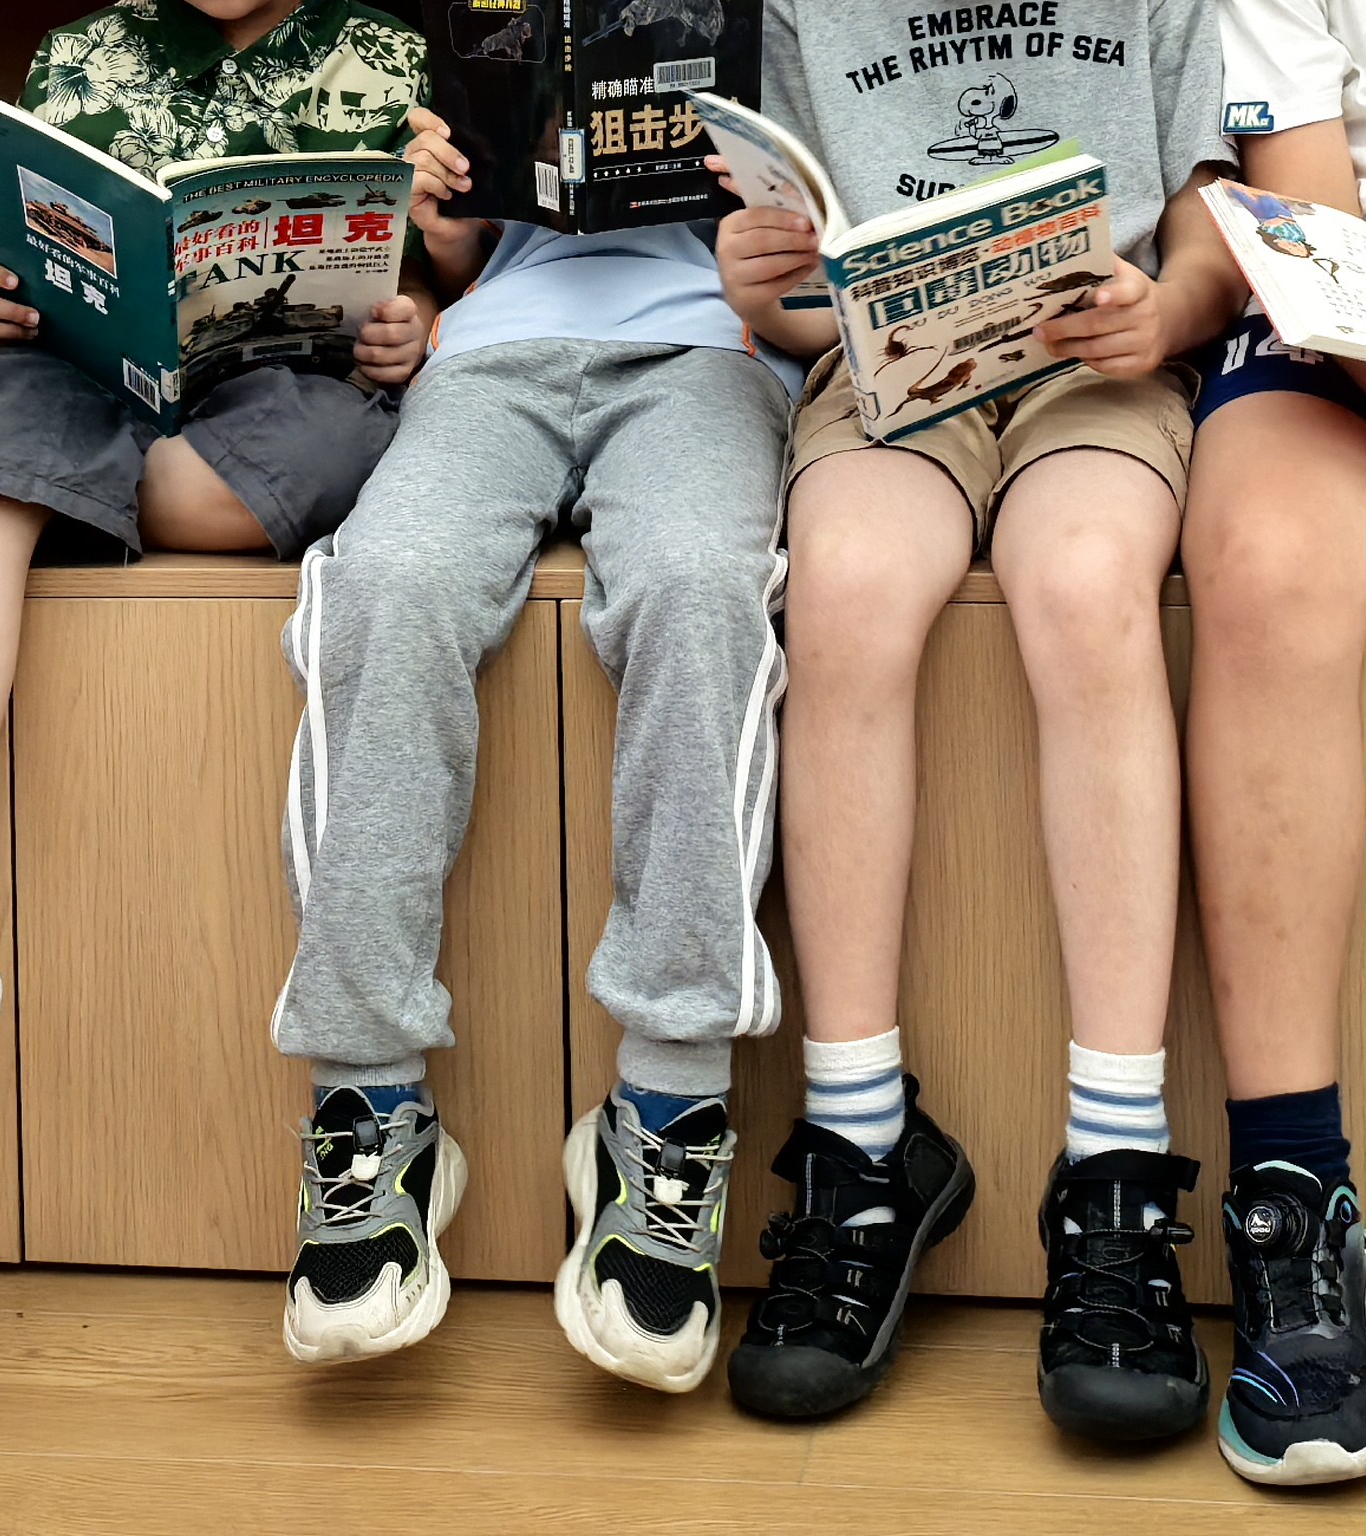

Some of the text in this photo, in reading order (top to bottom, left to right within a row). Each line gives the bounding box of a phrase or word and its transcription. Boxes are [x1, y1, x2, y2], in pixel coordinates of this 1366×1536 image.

[908, 1, 1058, 41] EMBRACE
[845, 31, 1126, 94] THE RHYTM OF SEA
[591, 76, 655, 101] 精确瞄准
[590, 100, 708, 157] 狙击步
[182, 174, 404, 204] THE BEST MILITARY ENCYCLOPEDIA
[272, 211, 395, 246] 坦克
[841, 177, 1104, 280] Science Book
[45, 258, 108, 315] 坦克
